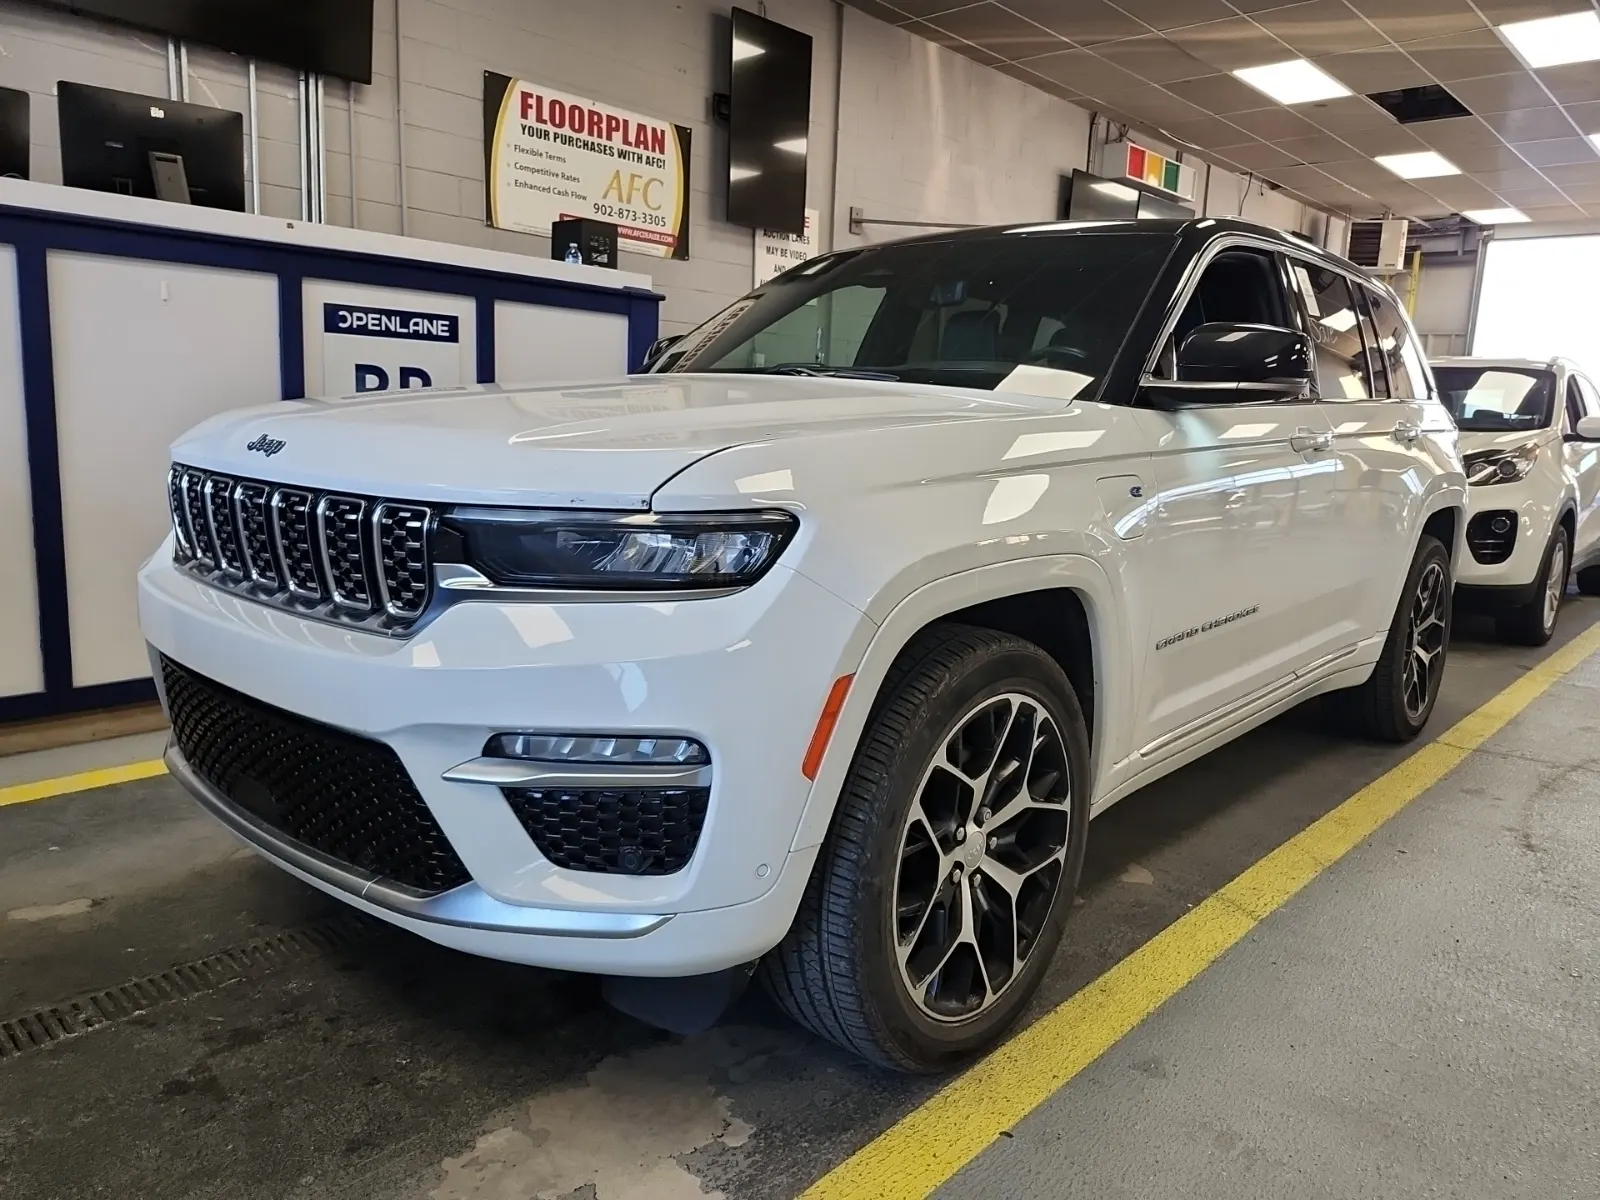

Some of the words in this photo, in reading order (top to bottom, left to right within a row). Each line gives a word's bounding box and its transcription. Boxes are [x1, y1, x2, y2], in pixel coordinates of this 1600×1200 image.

[520, 90, 666, 155] FLOORPLAN
[514, 144, 544, 159] Flexible
[545, 151, 567, 164] Terms
[521, 123, 550, 142] YOUR
[553, 132, 615, 158] PURCHASES
[617, 147, 643, 165] WITH
[645, 155, 666, 170] AFC!
[514, 162, 560, 180] Competitive
[561, 172, 581, 183] Rates
[514, 179, 551, 194] Enhanced
[552, 187, 570, 198] Cash
[571, 191, 588, 202] Flow
[602, 169, 664, 211] AFC
[593, 203, 667, 227] 902-873-3305
[763, 229, 790, 241] AUCTION
[766, 246, 779, 256] MAY
[780, 248, 788, 257] BE
[789, 250, 807, 261] VIDEO
[338, 311, 450, 336] OPENLANE
[246, 433, 287, 458] Jeep
